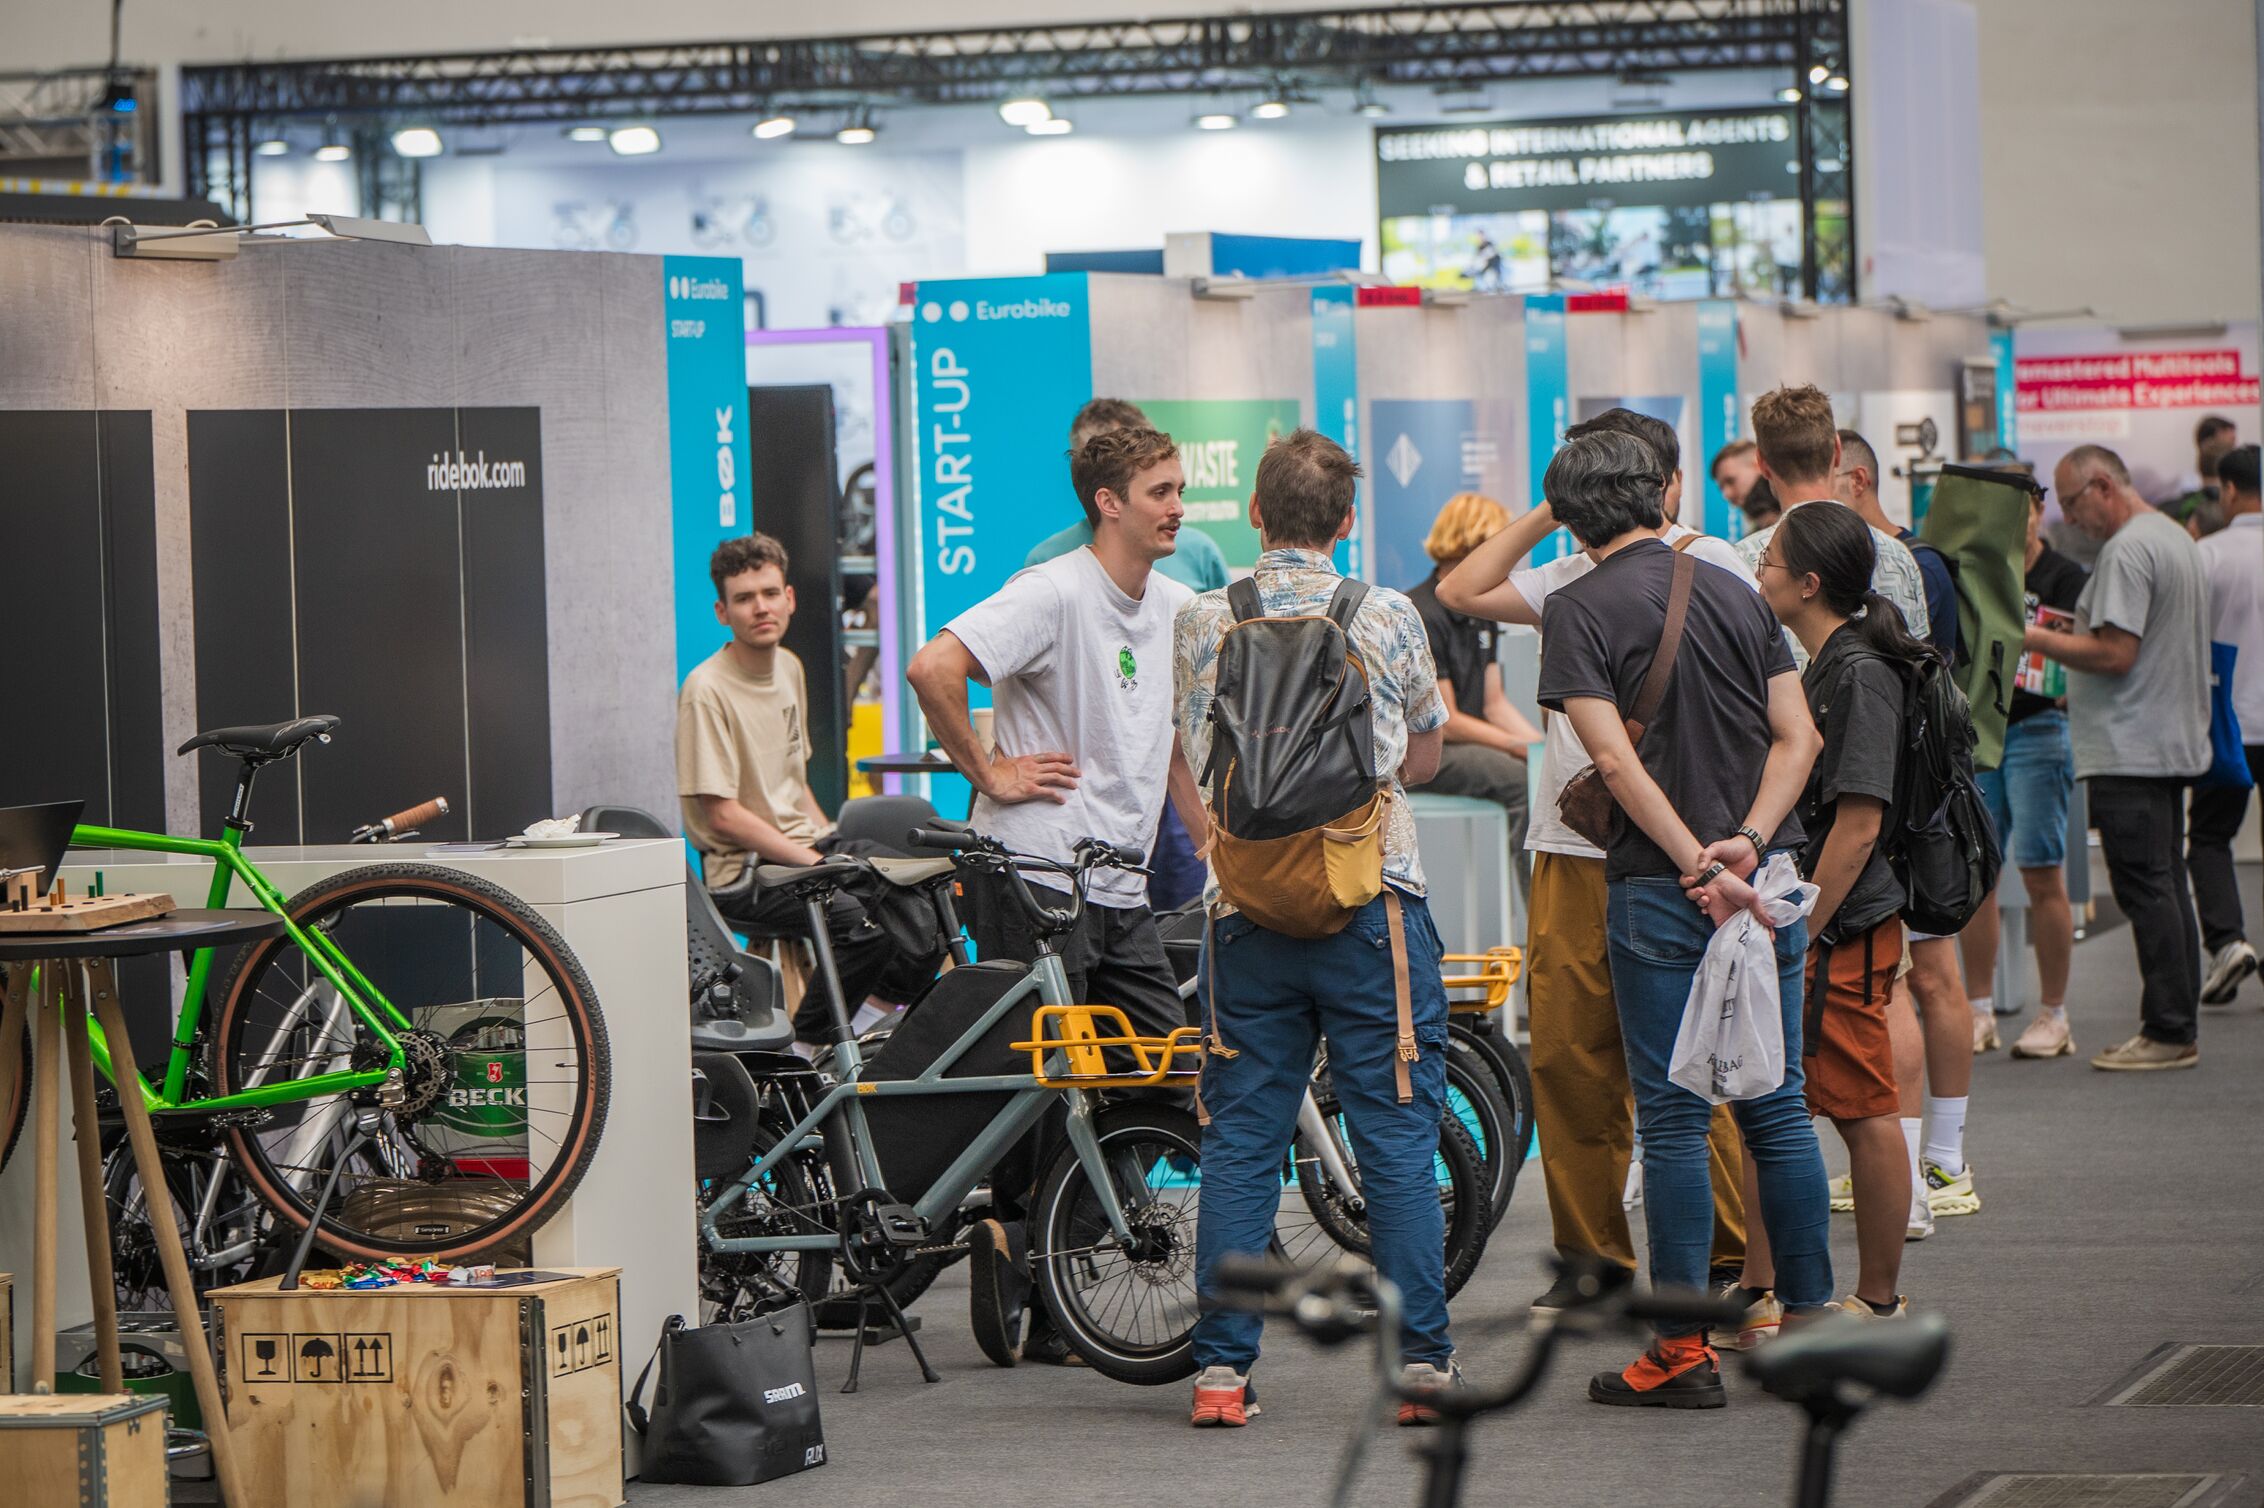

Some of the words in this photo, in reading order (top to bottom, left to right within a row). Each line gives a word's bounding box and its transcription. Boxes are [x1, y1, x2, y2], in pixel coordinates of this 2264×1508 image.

[1379, 130, 1489, 161] SEEKING
[1490, 121, 1685, 156] INTERNATIONAL
[1686, 115, 1790, 145] AGENTS
[1464, 162, 1489, 190] &
[1489, 158, 1578, 189] RETAIL
[1580, 153, 1714, 183] PARTNERS
[690, 277, 729, 300] Eurobike
[976, 298, 1071, 321] Eurobike
[427, 449, 525, 491] ridebok.com
[931, 347, 976, 574] START-UP
[763, 1383, 806, 1404] SRAM
